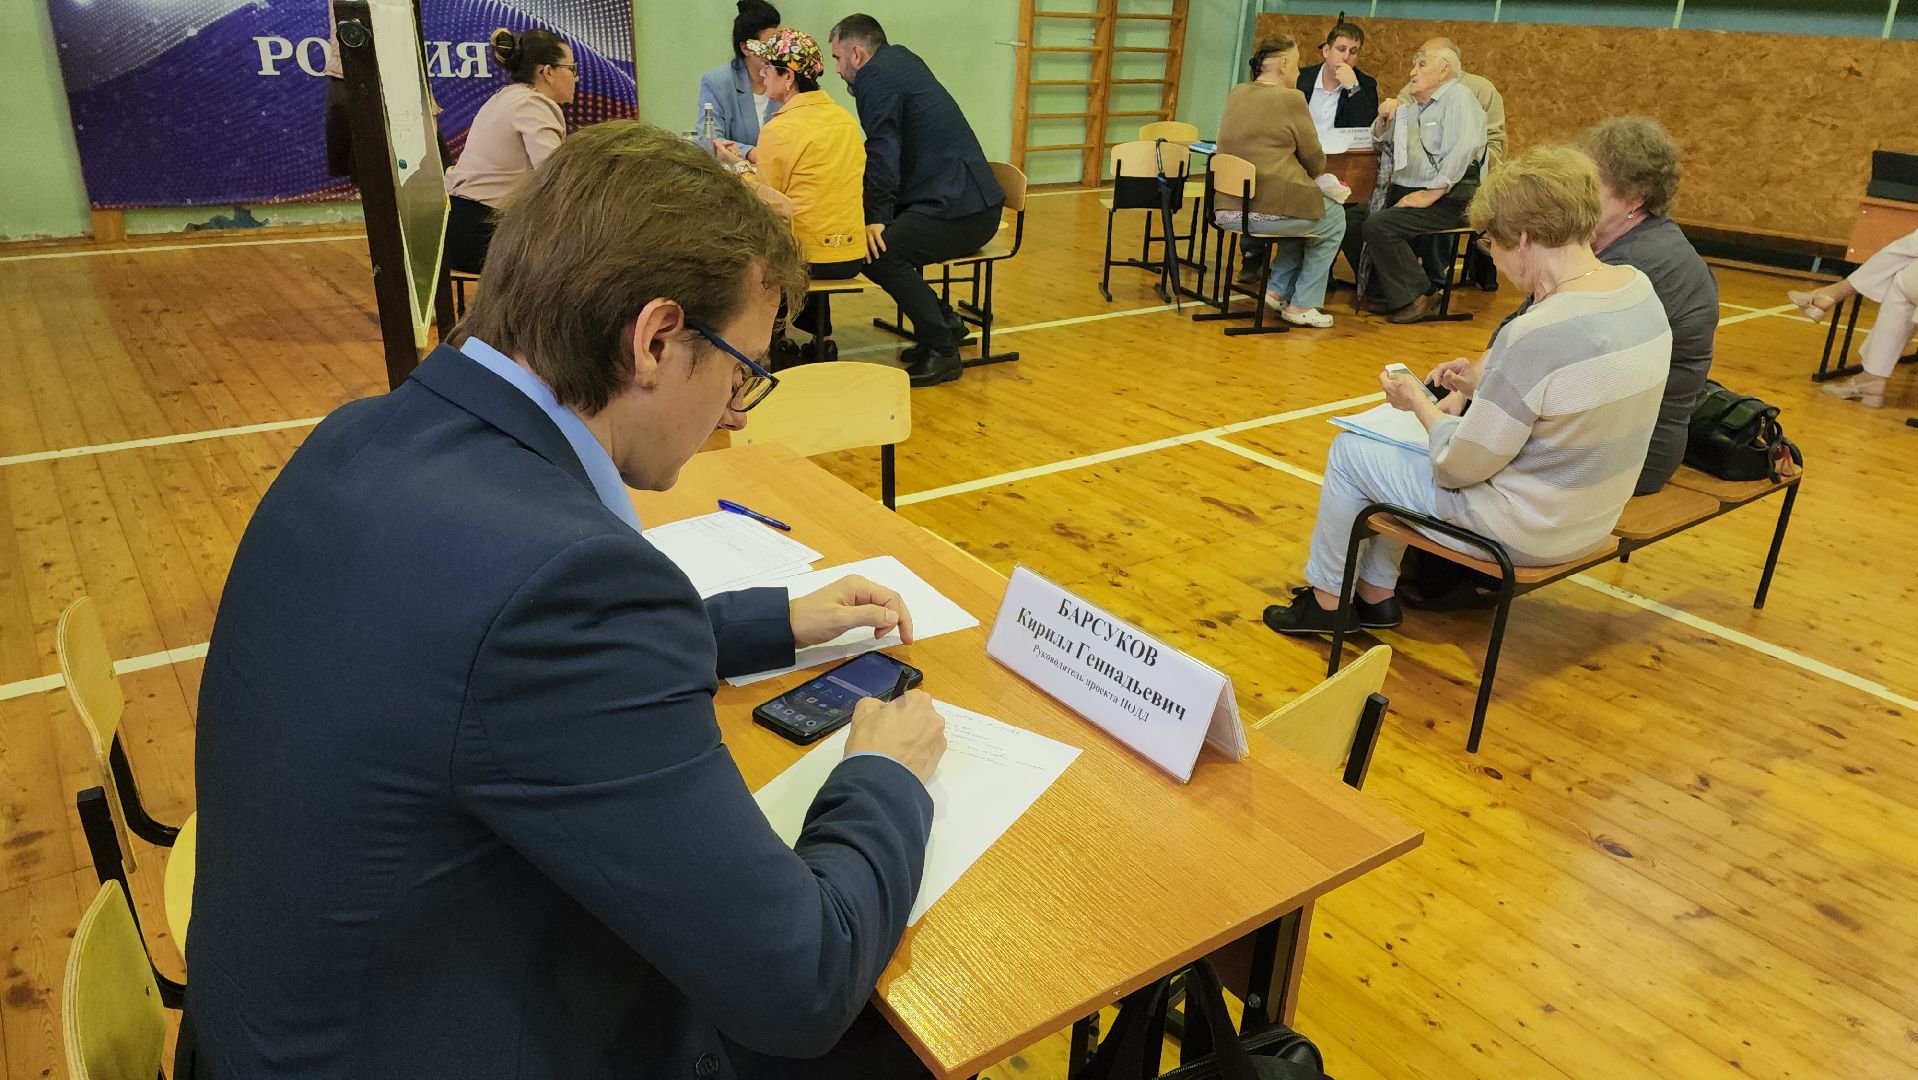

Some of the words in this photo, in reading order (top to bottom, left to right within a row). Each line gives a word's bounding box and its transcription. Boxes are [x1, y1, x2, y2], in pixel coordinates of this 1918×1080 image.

[252, 36, 492, 79] РОИЯ
[1017, 607, 1074, 654] Кирилл
[1075, 641, 1187, 721] Геннадьевич
[1057, 598, 1158, 667] БАРСУКОВ
[1032, 644, 1084, 682] Руководитель
[1085, 678, 1119, 704] проекта
